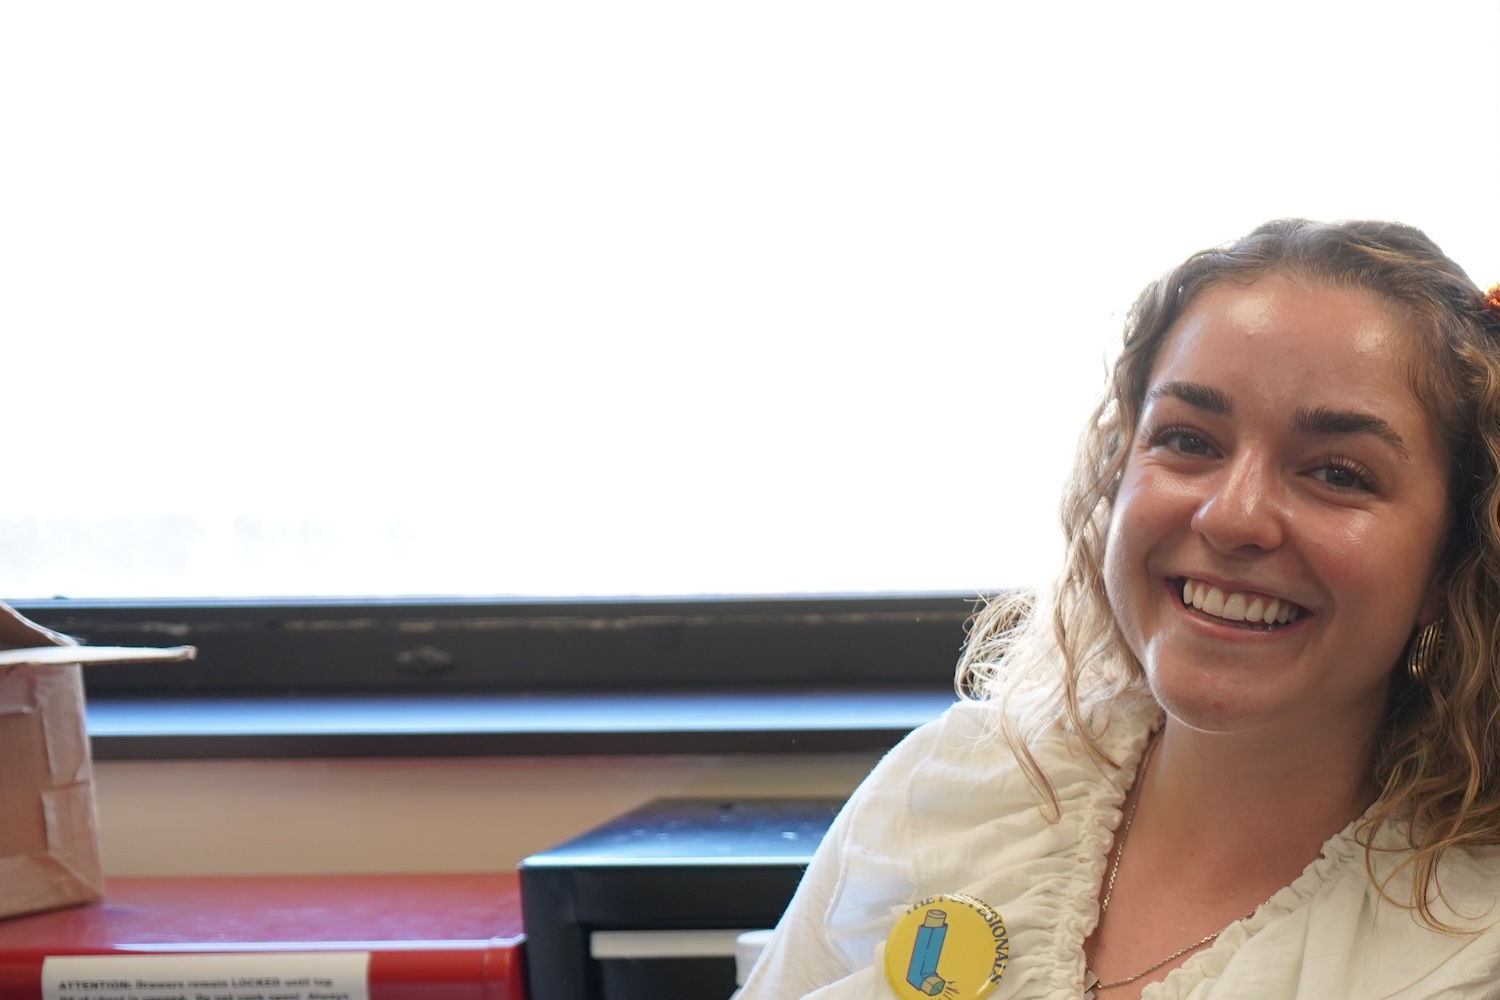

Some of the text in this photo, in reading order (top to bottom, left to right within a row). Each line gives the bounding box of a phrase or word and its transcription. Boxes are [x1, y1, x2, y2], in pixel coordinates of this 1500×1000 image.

[134, 979, 185, 989] Drawers
[186, 978, 229, 988] remain
[230, 978, 281, 988] LOCKED
[283, 978, 311, 988] until
[312, 978, 334, 988] top
